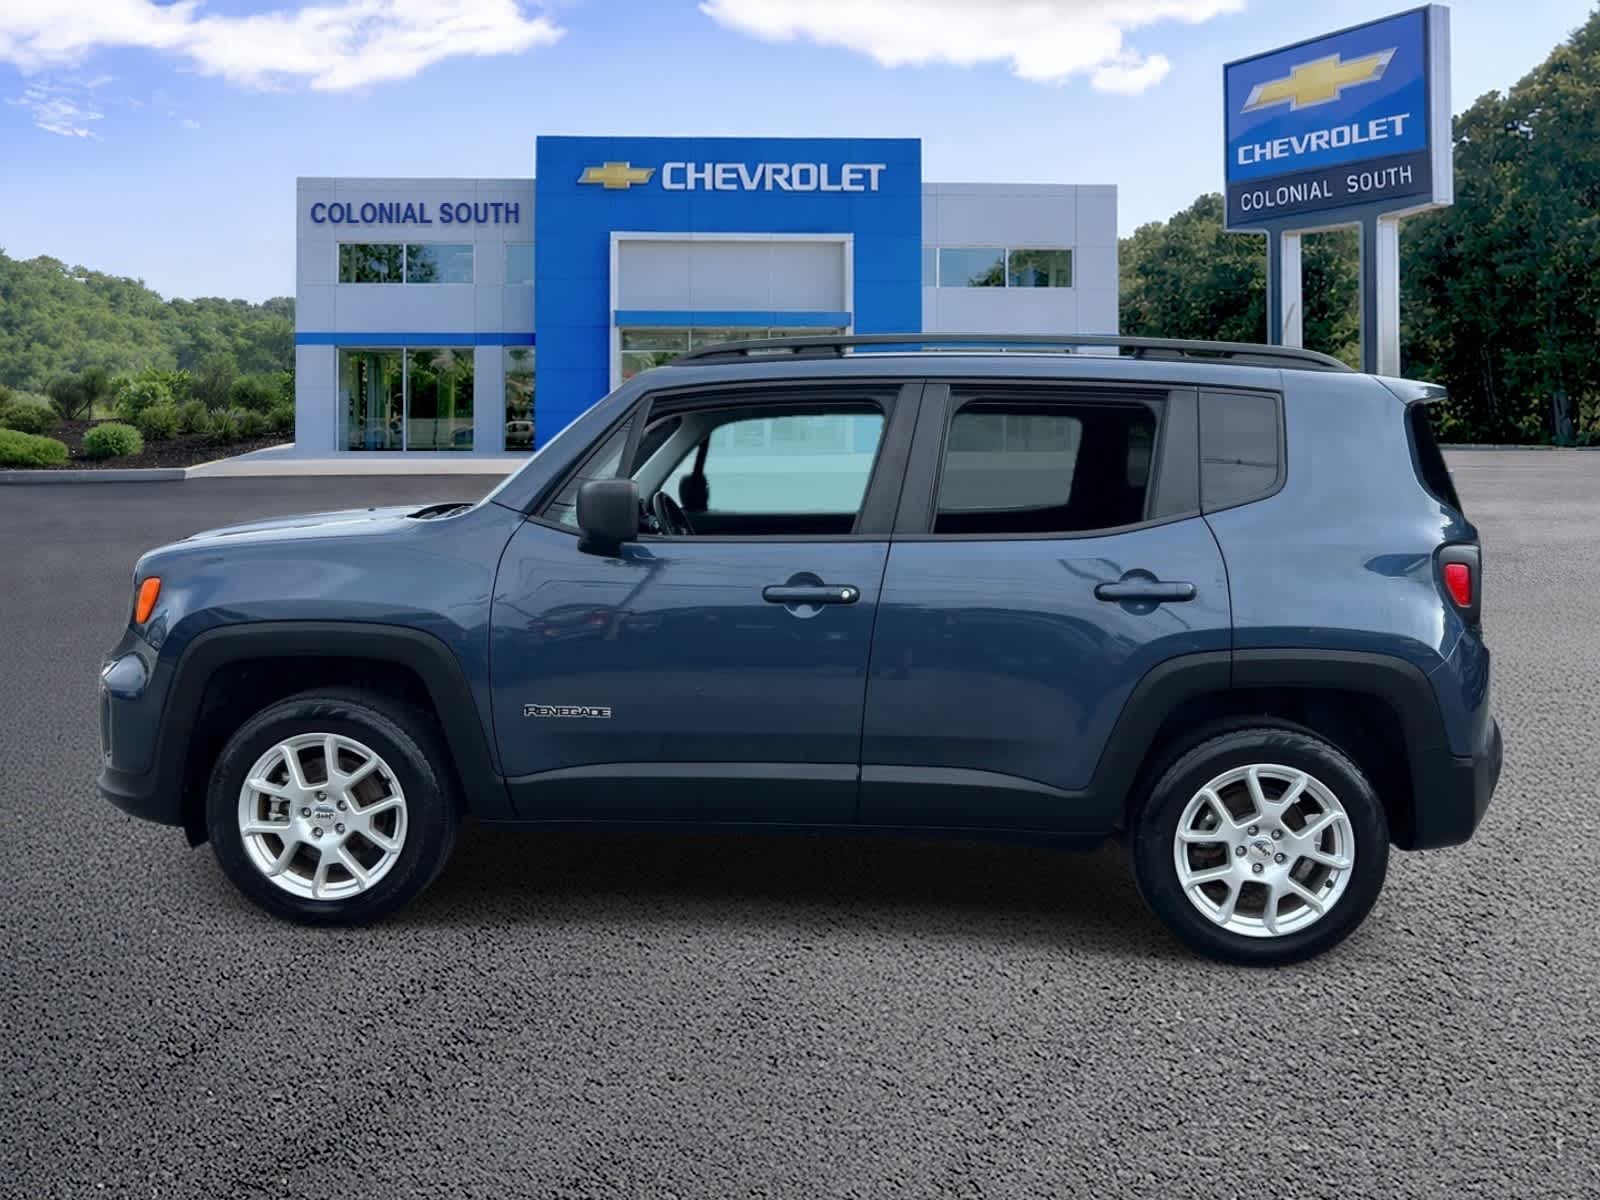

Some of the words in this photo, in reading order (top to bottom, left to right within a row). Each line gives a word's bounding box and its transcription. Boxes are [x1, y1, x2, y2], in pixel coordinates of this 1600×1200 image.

[1237, 113, 1410, 165] CHEVROLET
[661, 162, 887, 192] CHEVROLET
[1240, 180, 1333, 211] COLONIAL
[1346, 165, 1412, 193] SOUTH
[310, 202, 433, 224] COLONIAL
[439, 202, 520, 224] SOUTH
[523, 703, 612, 719] RENEGADE
